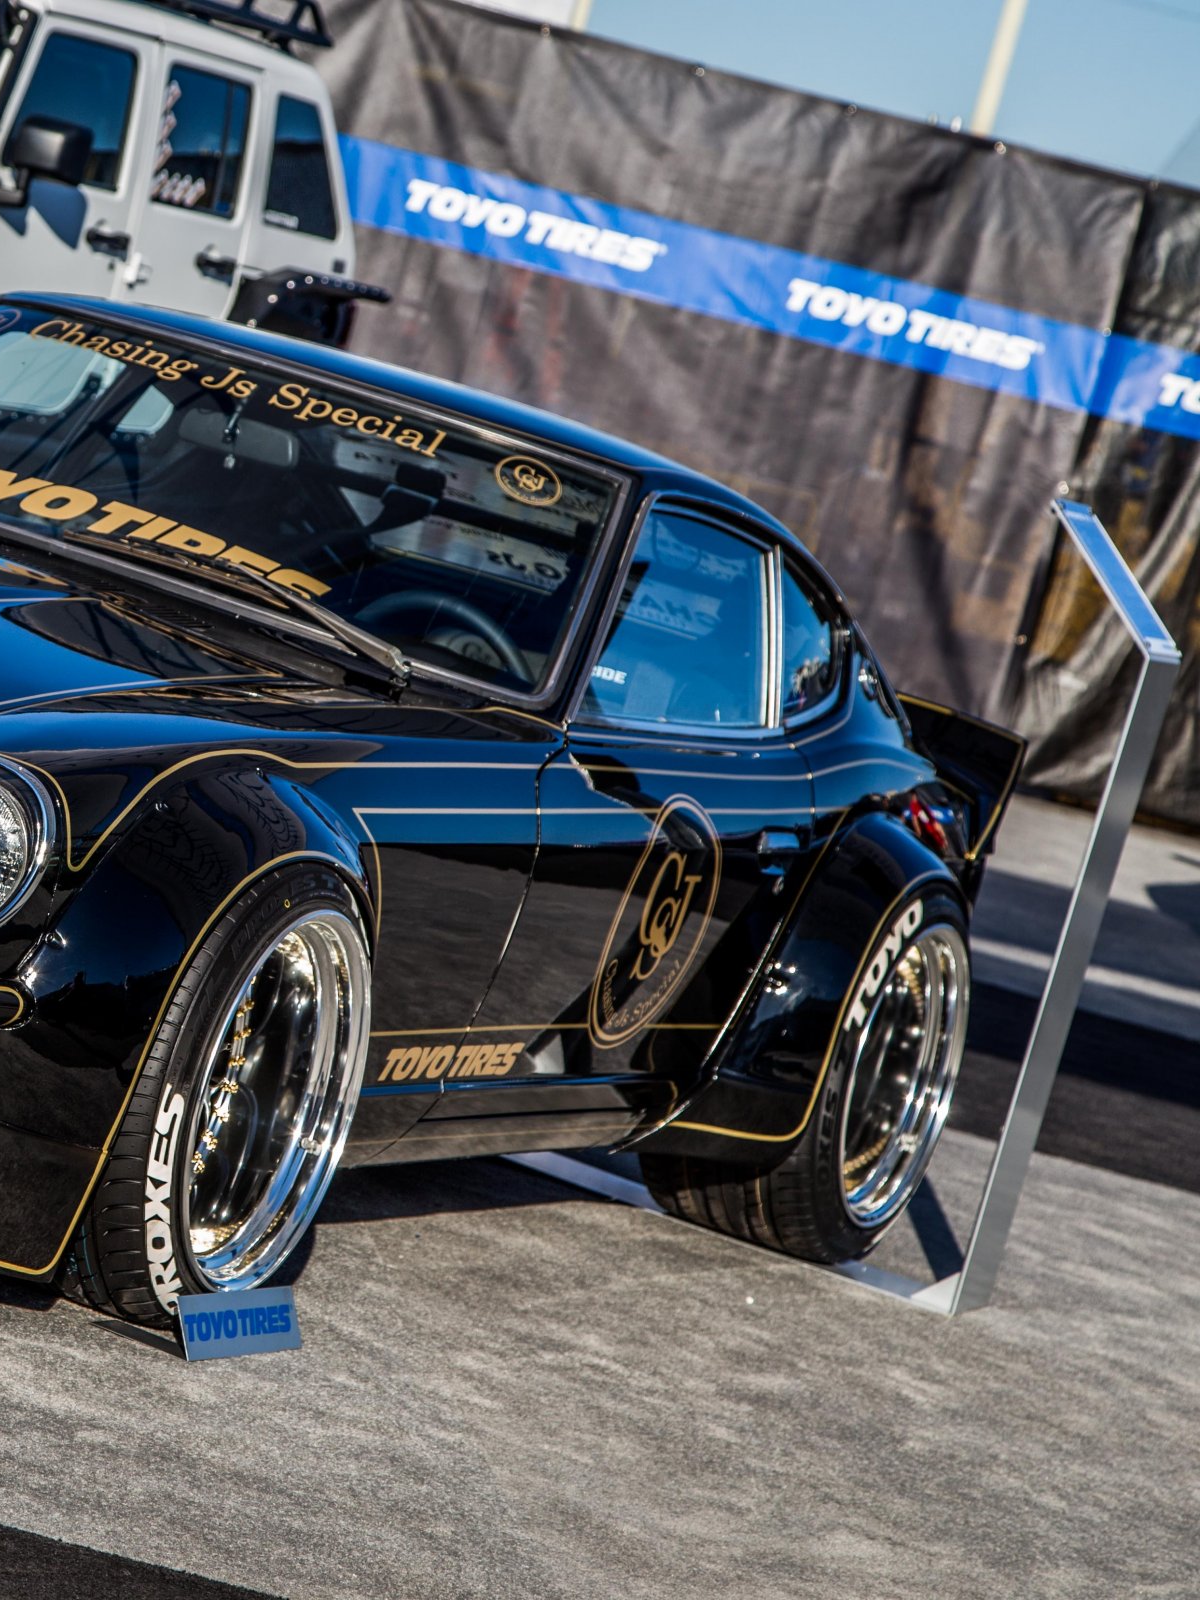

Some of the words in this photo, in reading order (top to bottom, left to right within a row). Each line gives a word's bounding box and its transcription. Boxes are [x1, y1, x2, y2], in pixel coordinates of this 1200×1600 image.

[405, 178, 527, 238] TOYO
[524, 210, 661, 273] TIRES
[786, 278, 907, 336] TOYO
[905, 309, 1038, 371] TIRES
[30, 320, 199, 381] Chasing
[201, 367, 259, 399] Js
[268, 383, 448, 458] Special
[843, 898, 923, 1031] TOYO
[377, 1046, 456, 1081] TOYO
[448, 1042, 526, 1077] TIRES
[184, 1310, 239, 1343] TOYO
[237, 1304, 291, 1337] TIRES
